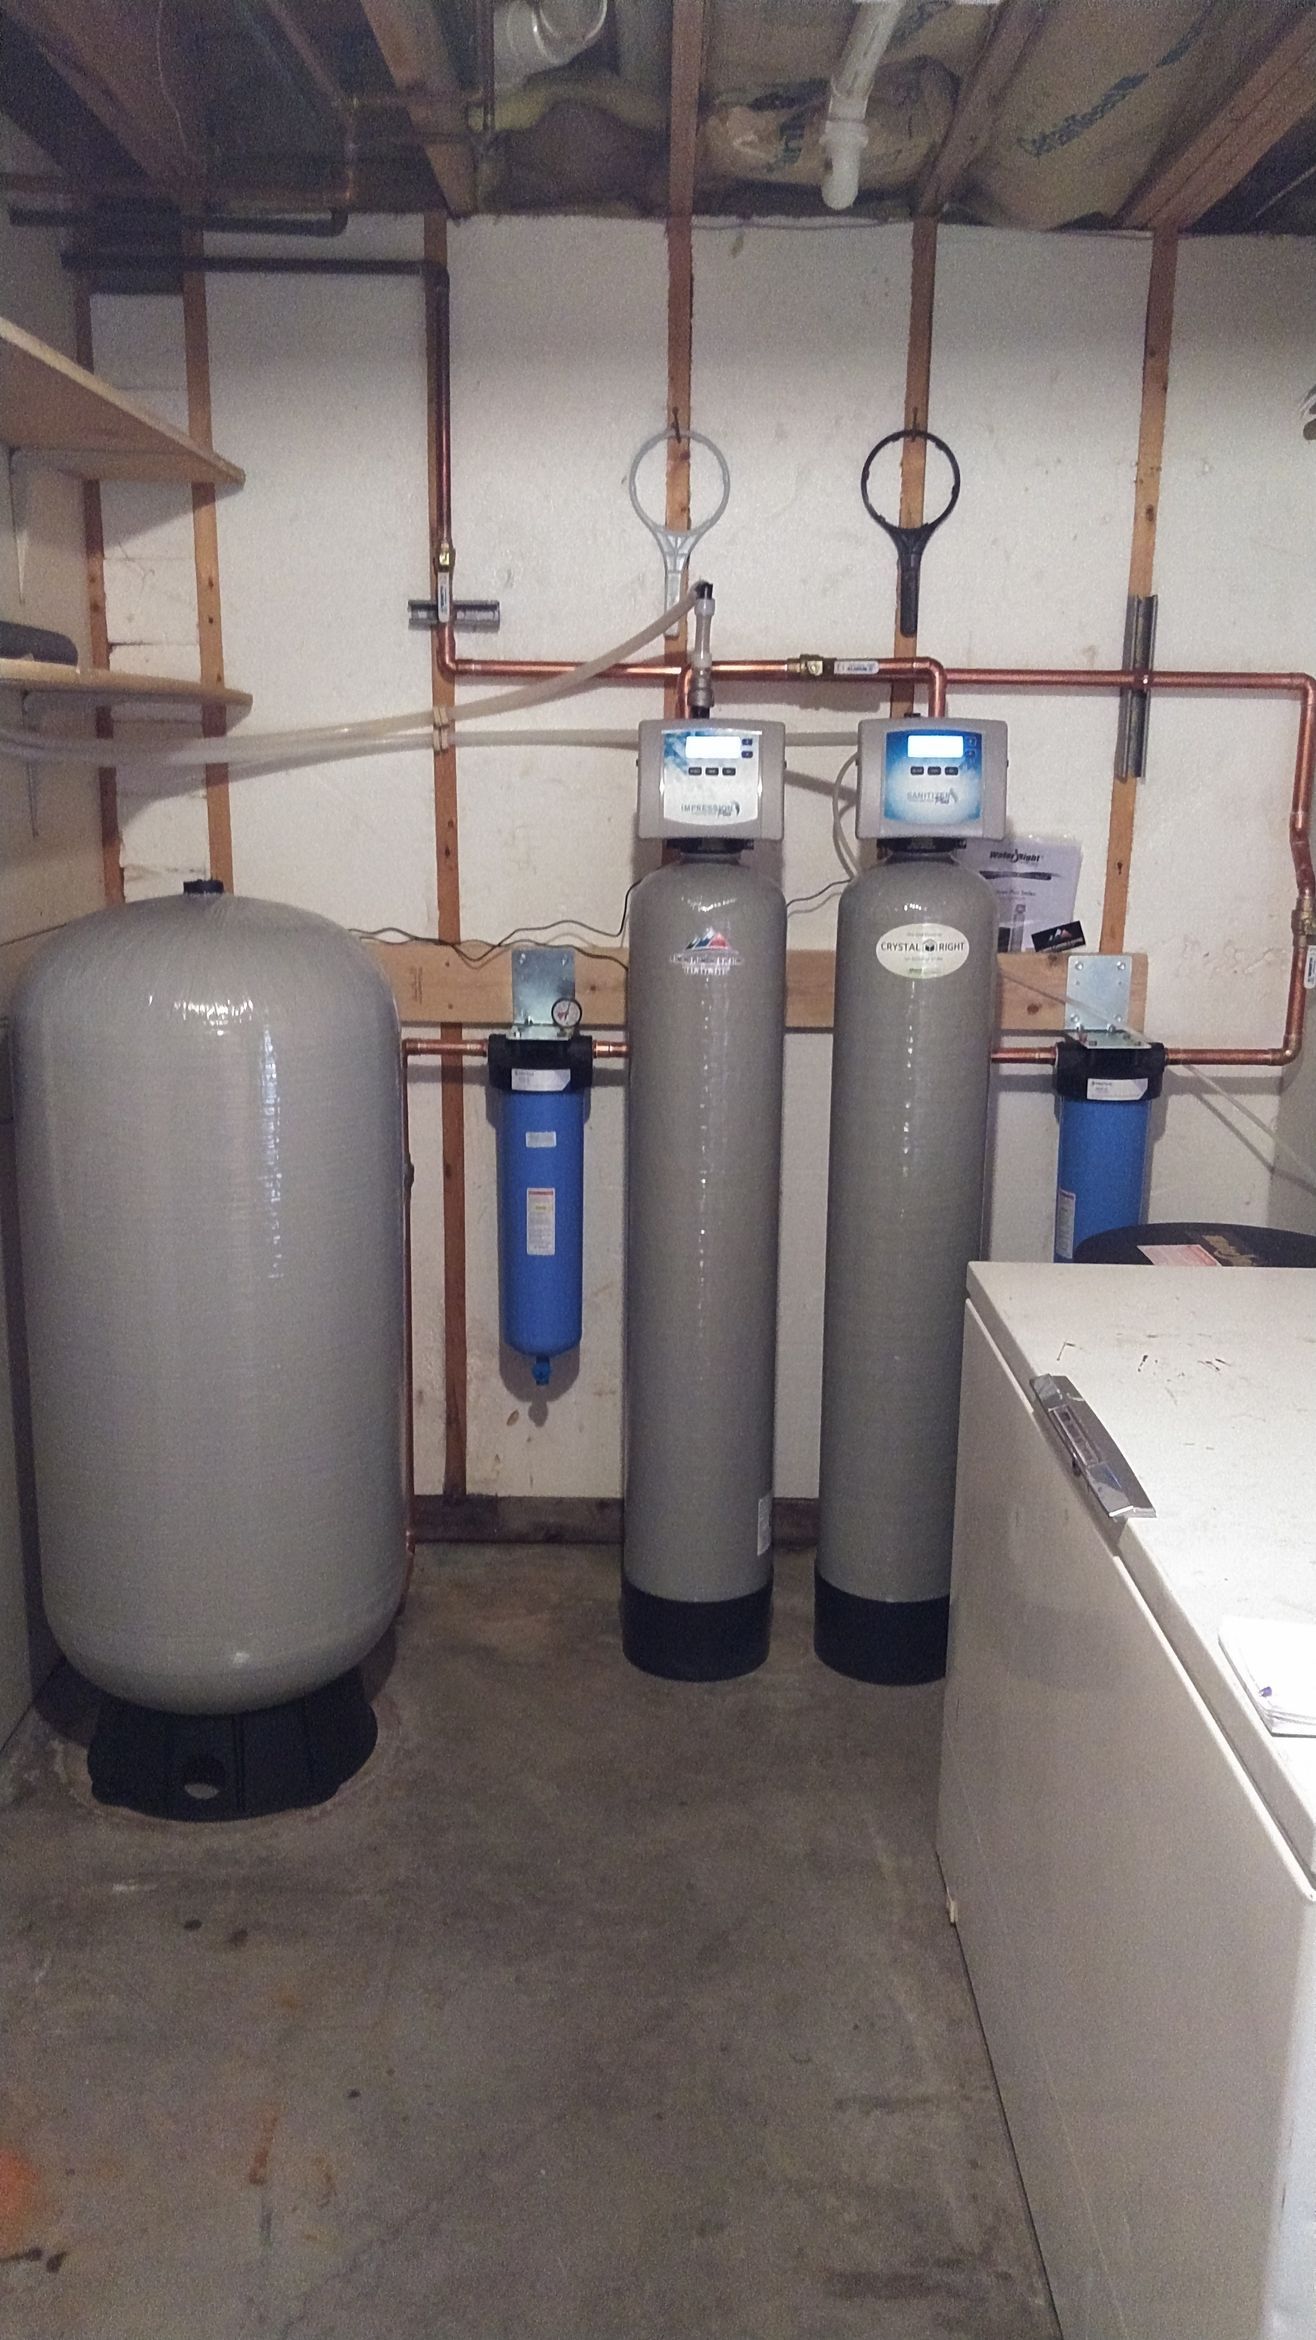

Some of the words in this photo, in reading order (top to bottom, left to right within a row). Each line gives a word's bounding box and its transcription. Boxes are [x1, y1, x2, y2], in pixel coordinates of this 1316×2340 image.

[681, 803, 733, 813] IMPRESSION
[880, 942, 920, 952] CRYSTAL
[938, 941, 965, 952] RIGHT
